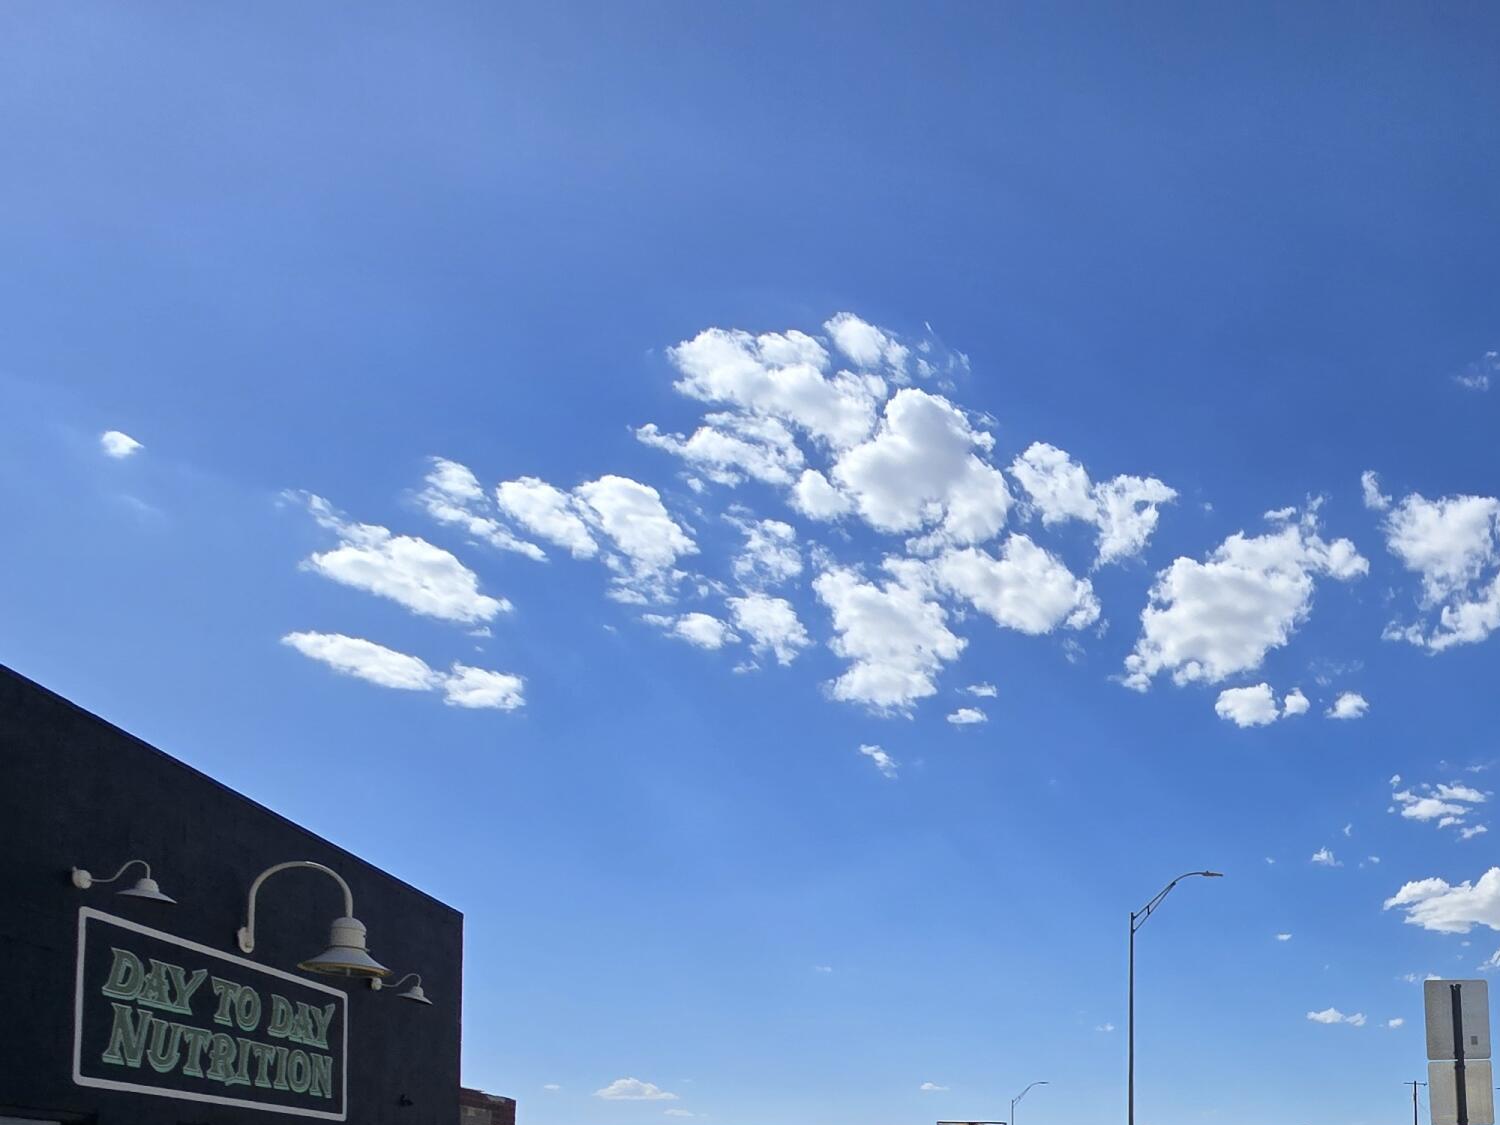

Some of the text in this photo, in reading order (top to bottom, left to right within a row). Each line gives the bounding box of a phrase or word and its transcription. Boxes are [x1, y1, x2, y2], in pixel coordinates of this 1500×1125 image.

[102, 947, 335, 1049] DAY TO DAY
[102, 1002, 332, 1098] NUTRITION
